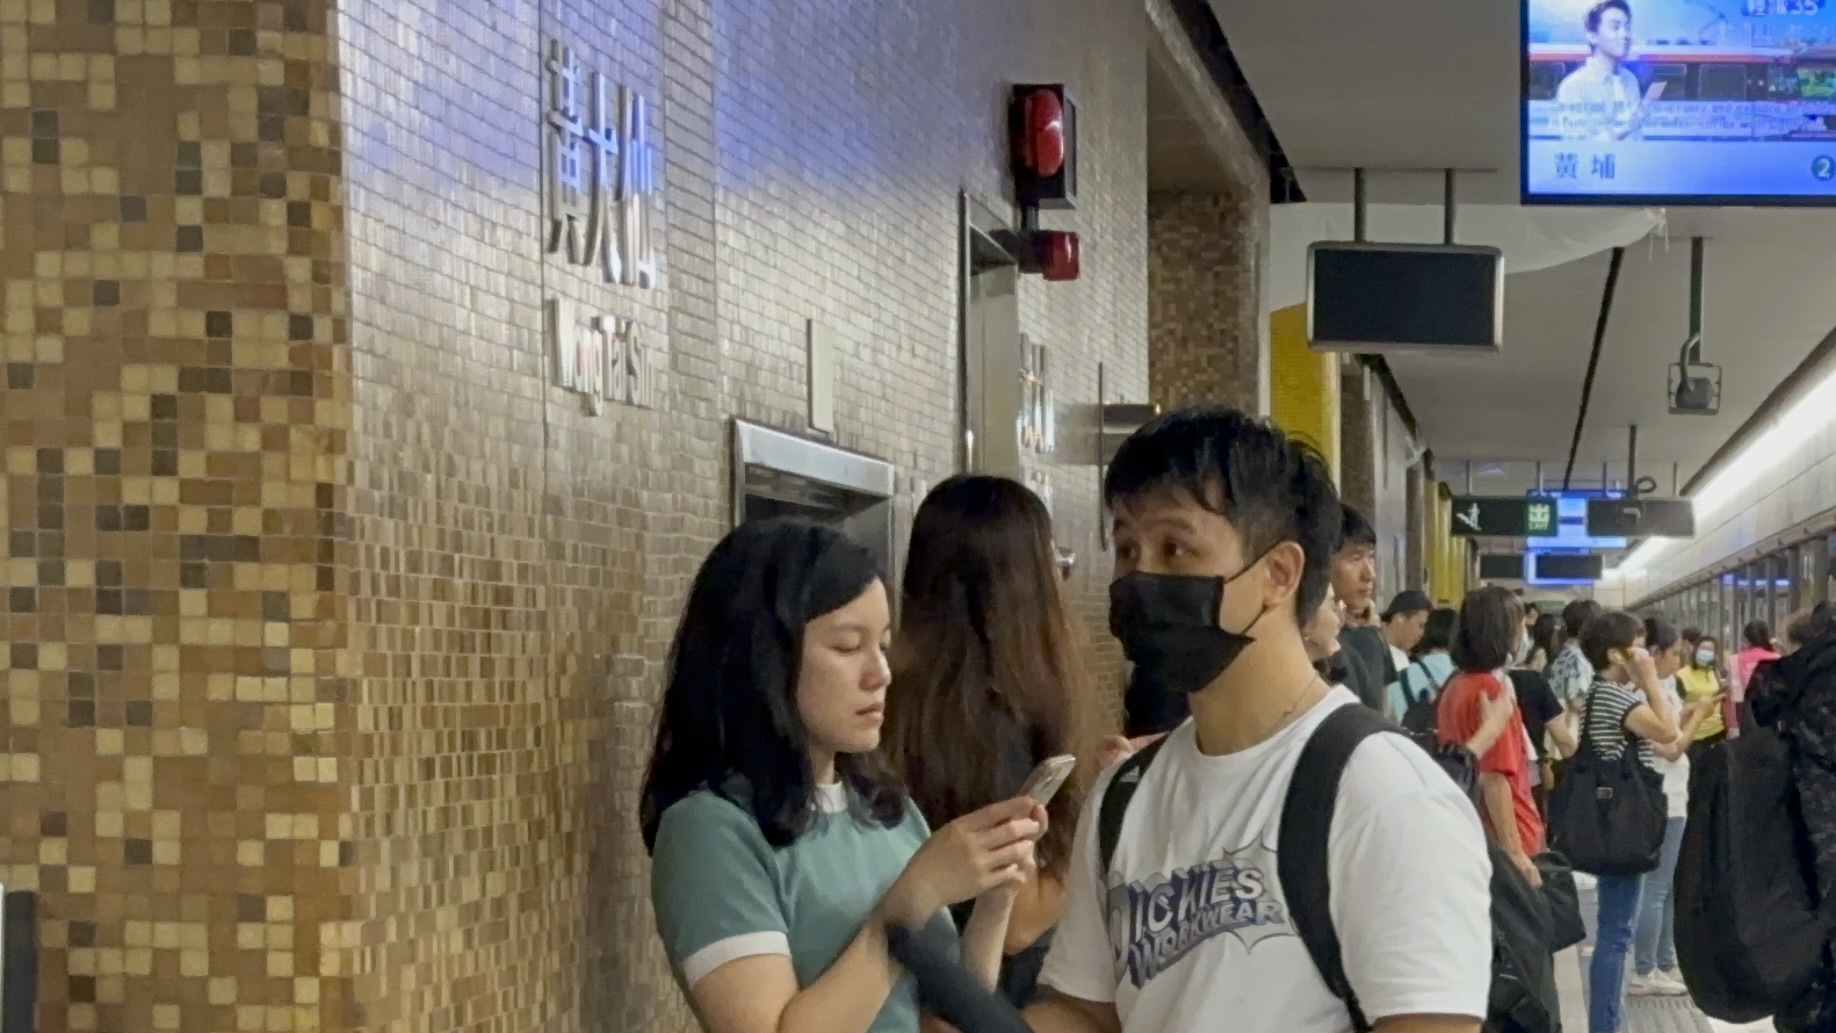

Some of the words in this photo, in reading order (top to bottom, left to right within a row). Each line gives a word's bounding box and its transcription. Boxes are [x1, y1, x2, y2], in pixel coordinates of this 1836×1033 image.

[548, 39, 656, 290] 黃大仙
[1817, 158, 1831, 179] 2
[1528, 502, 1551, 523] 出
[1109, 862, 1265, 972] DICKIES
[1129, 899, 1286, 988] WORKWEAR
